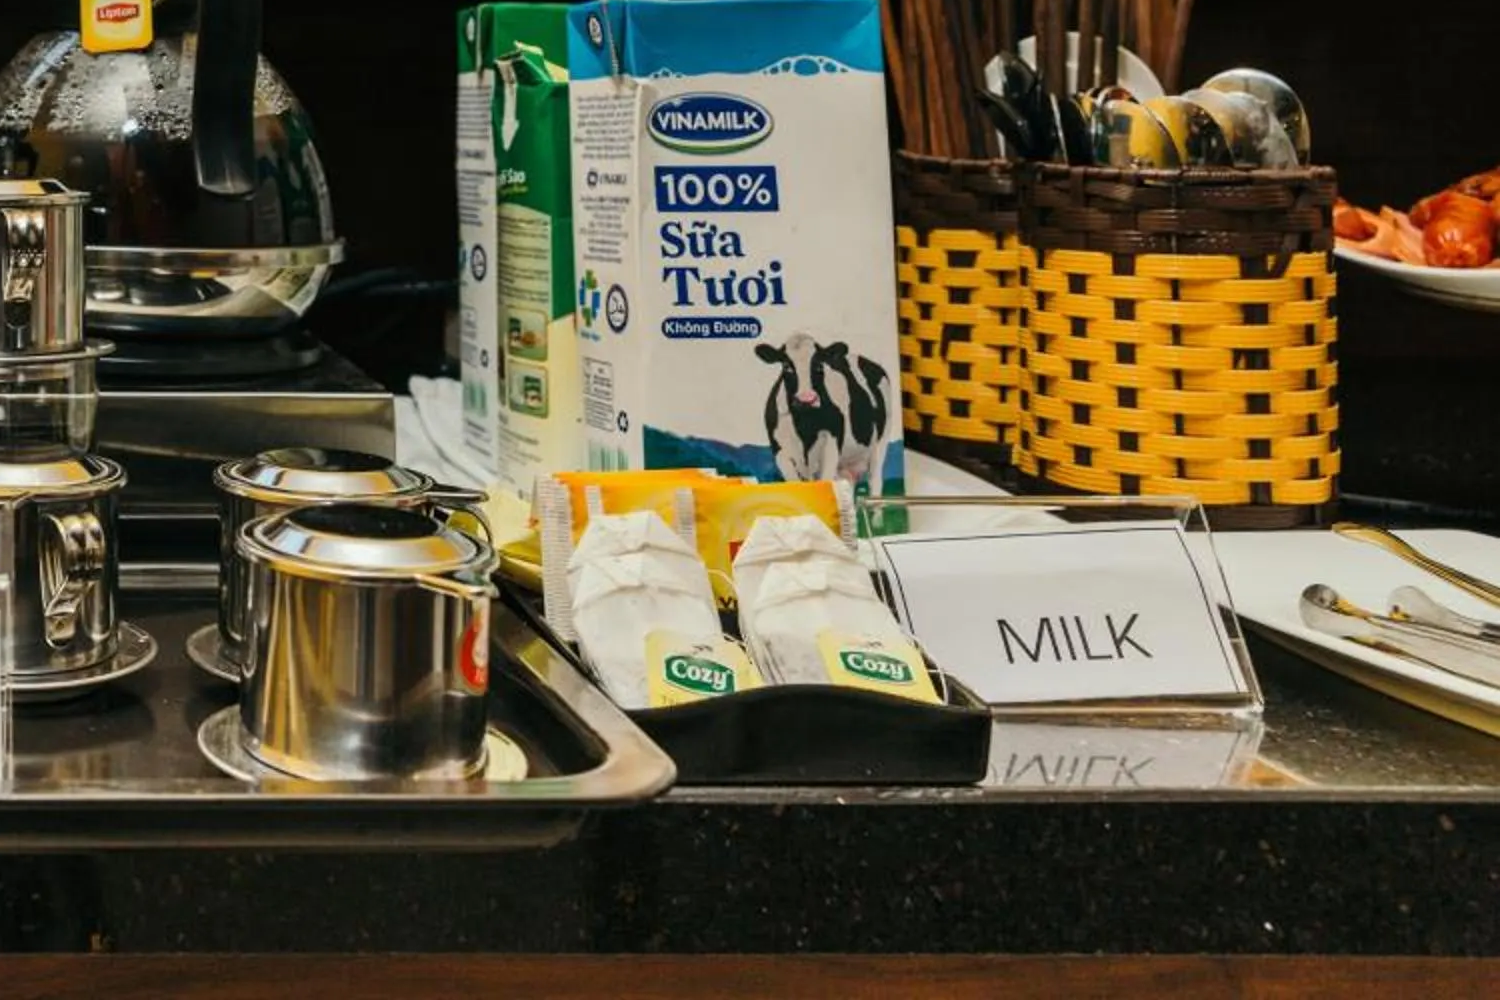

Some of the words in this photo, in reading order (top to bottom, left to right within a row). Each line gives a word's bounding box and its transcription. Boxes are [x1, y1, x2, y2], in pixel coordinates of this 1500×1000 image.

[656, 111, 761, 131] VINAMILK
[660, 172, 772, 206] 100%
[660, 220, 747, 259] Sữa
[662, 259, 789, 307] Tươi
[996, 612, 1154, 664] MILK
[670, 658, 729, 692] Cozy
[846, 652, 906, 681] Cozy
